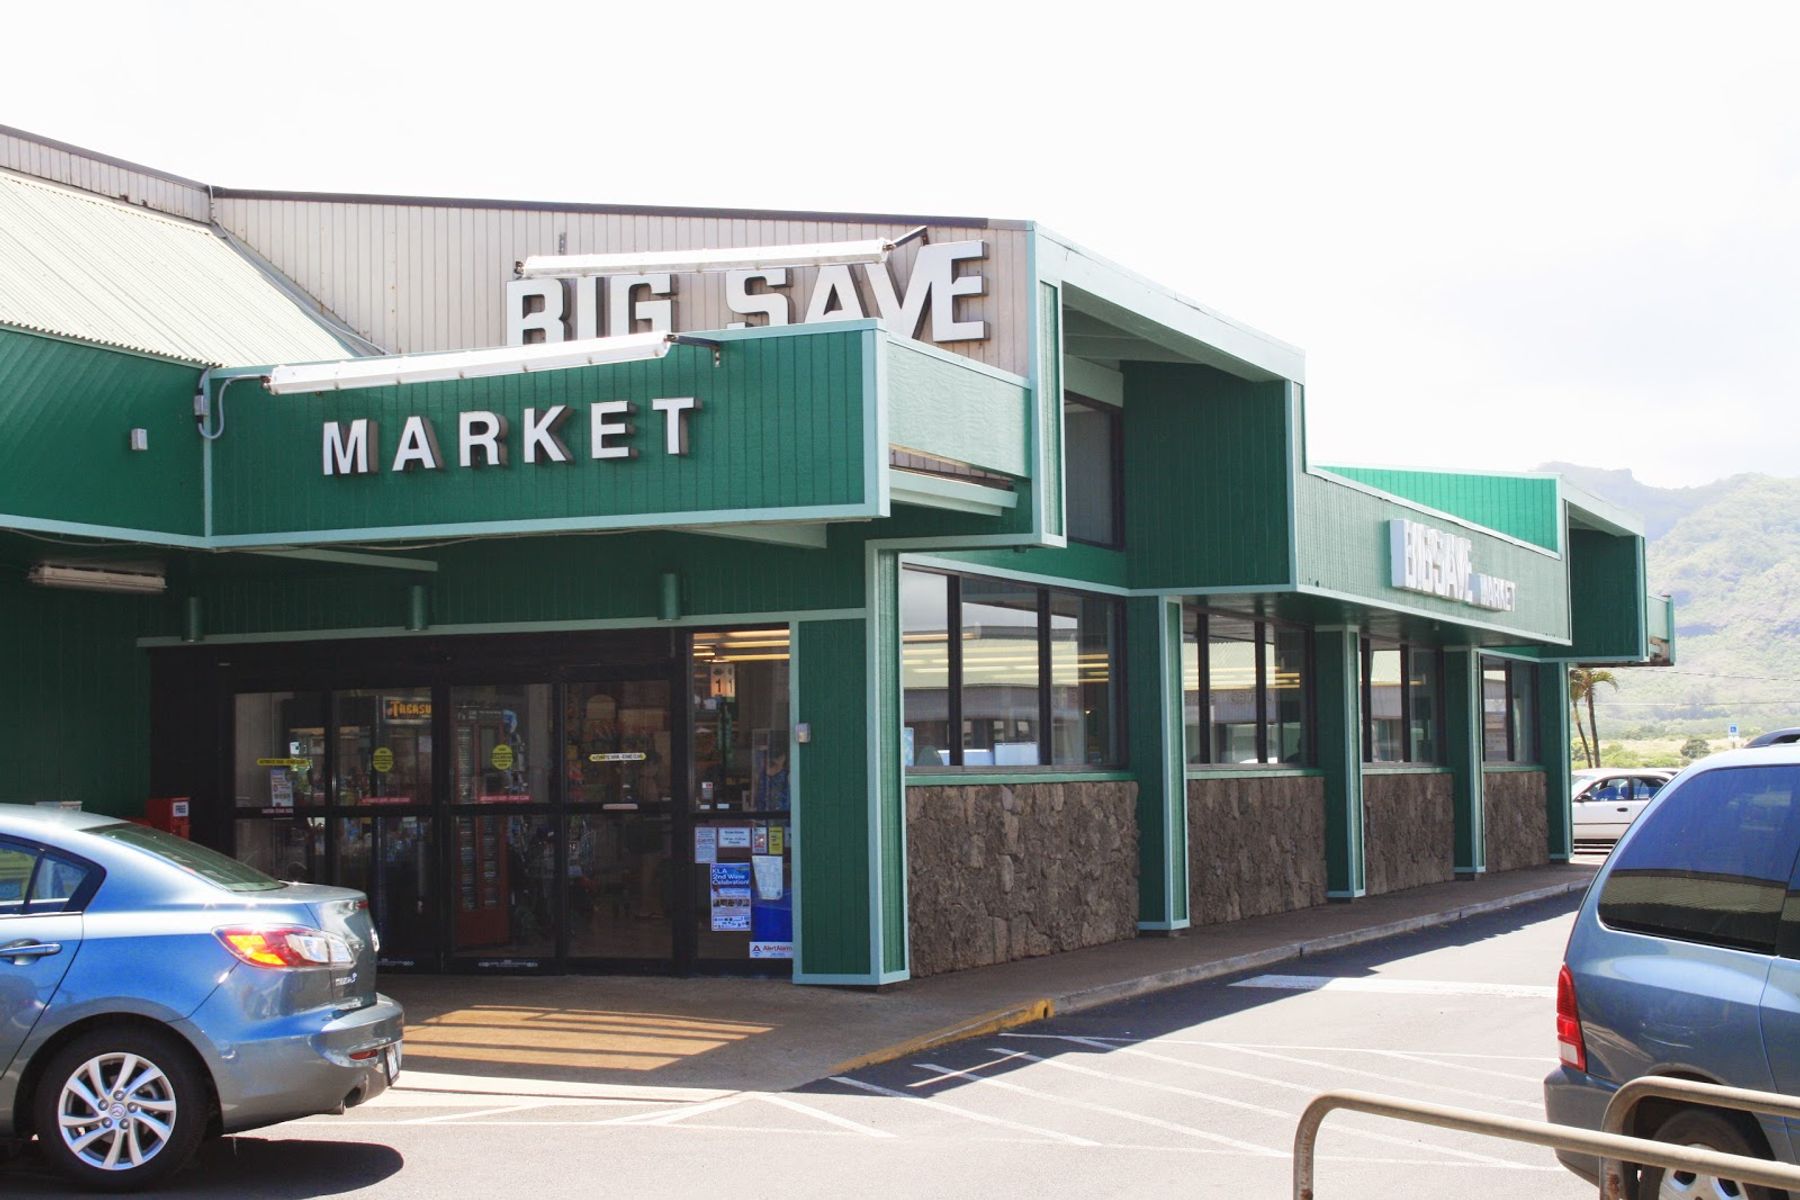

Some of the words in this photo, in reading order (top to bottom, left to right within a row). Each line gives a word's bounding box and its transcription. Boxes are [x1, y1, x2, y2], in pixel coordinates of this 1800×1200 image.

[506, 272, 676, 346] BIG
[726, 240, 988, 342] SAVE
[323, 397, 700, 476] MARKET
